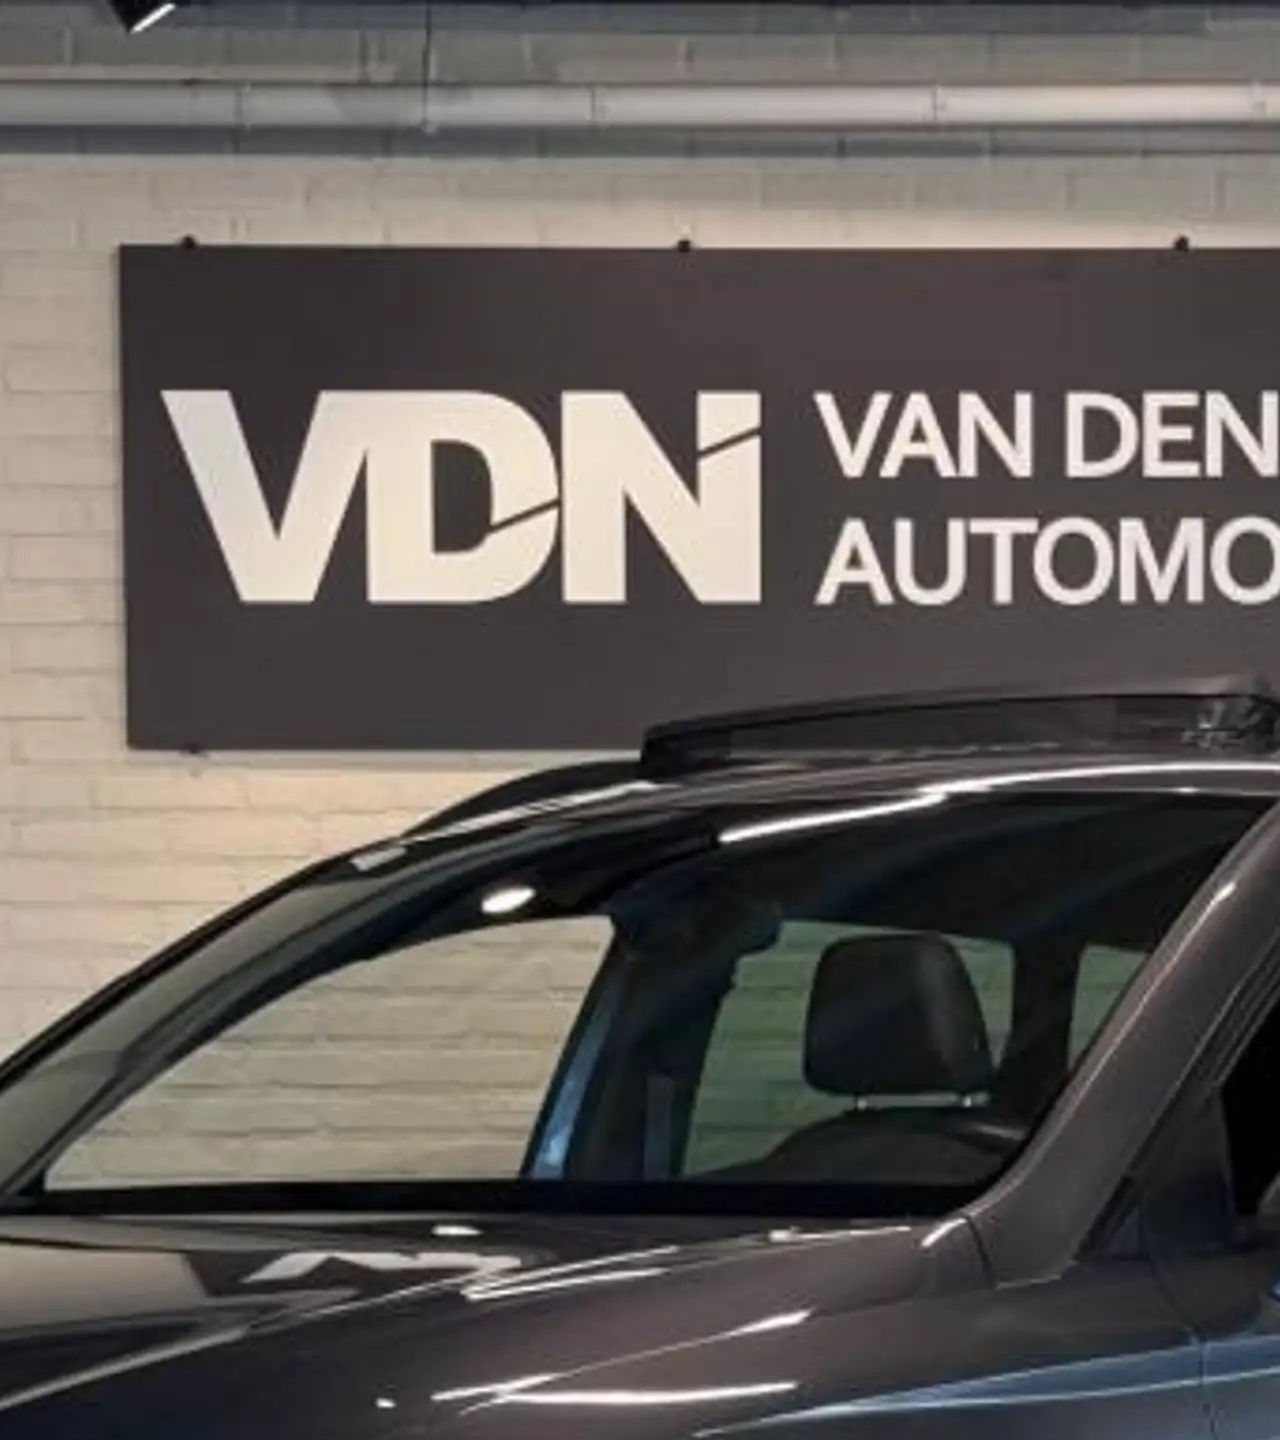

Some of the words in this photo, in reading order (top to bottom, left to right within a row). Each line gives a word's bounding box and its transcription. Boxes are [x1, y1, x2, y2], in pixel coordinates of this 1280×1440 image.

[161, 389, 762, 604] VDN
[813, 391, 1033, 478] VAN
[1065, 391, 1279, 478] DEN
